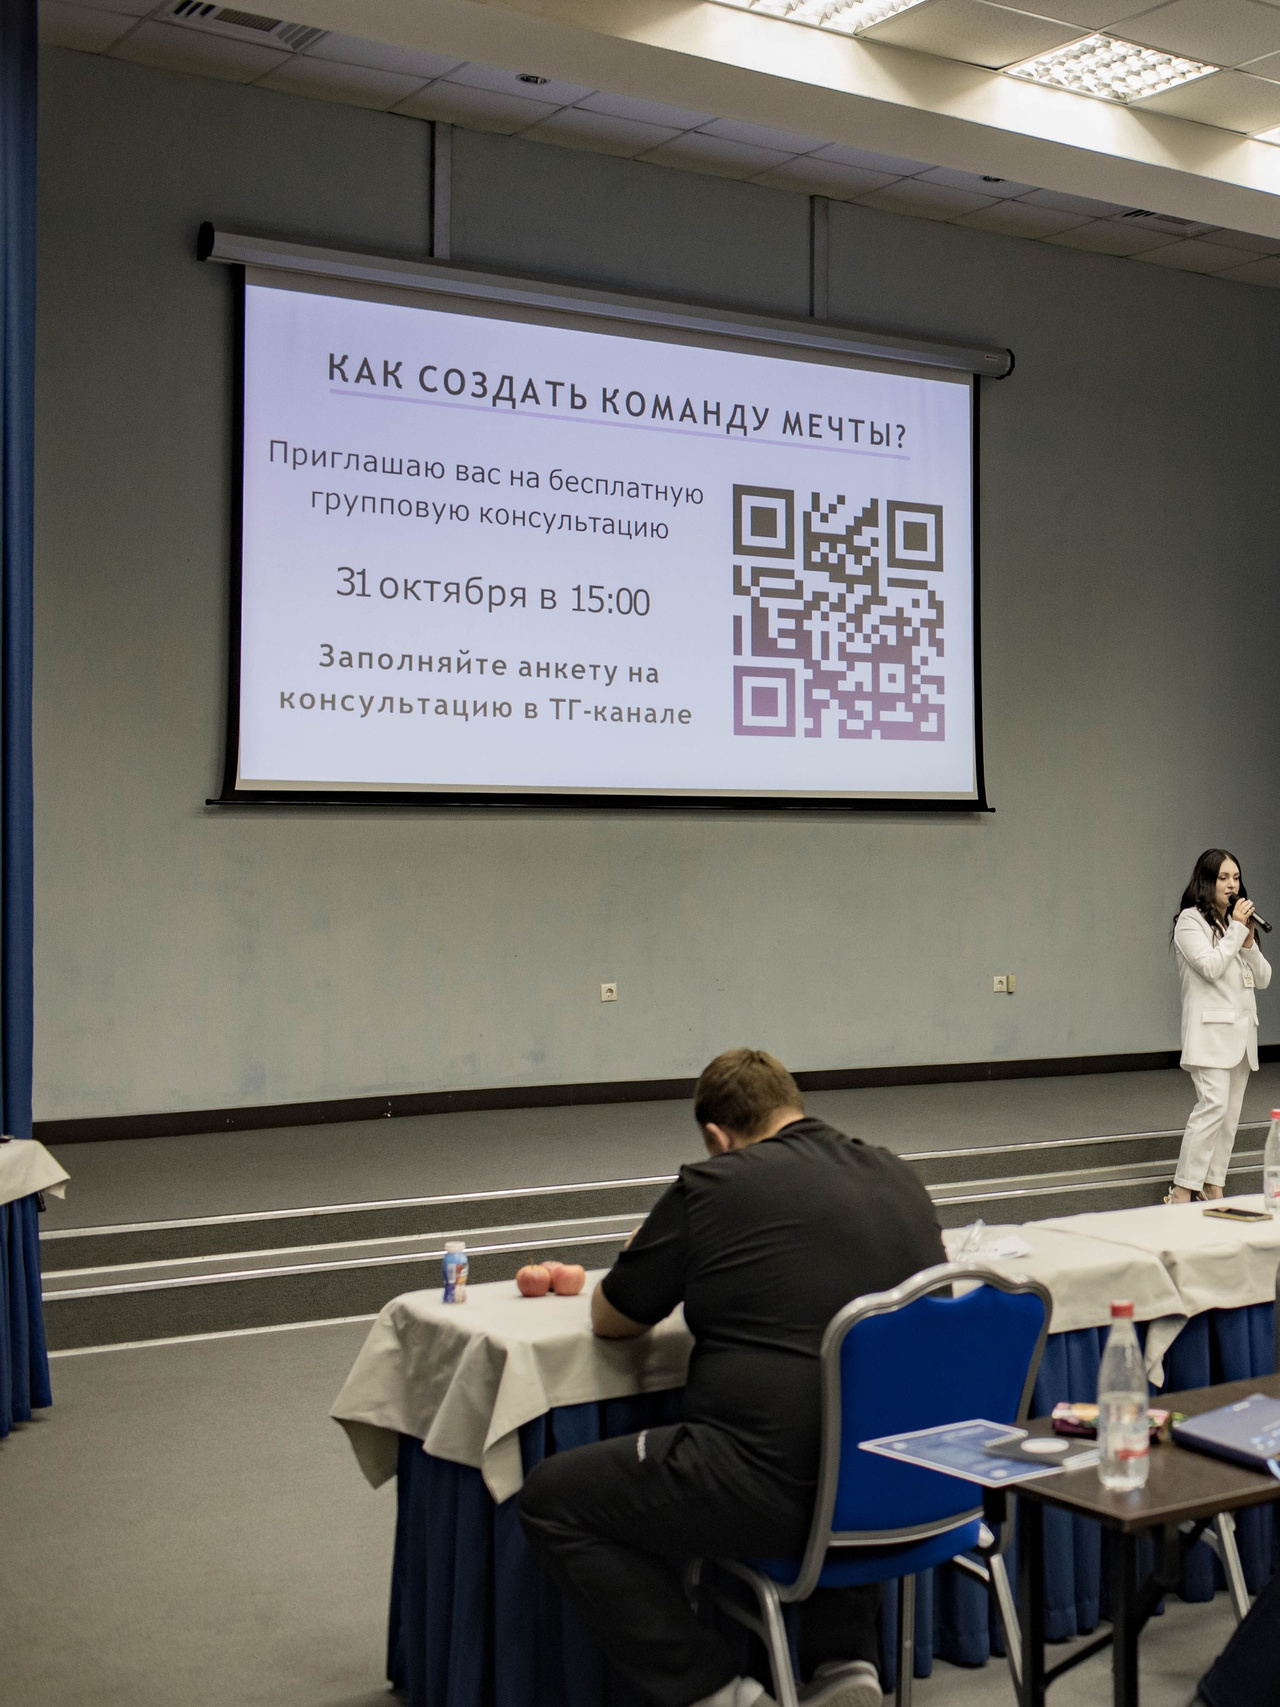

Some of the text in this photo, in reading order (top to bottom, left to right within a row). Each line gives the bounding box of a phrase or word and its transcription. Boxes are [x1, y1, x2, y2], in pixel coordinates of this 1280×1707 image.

[328, 352, 907, 449] КАК СОЗДАТЬ КОМАНДУ МЕЧТЫ?
[269, 439, 704, 508] Приглашаю вас на бесплатную
[311, 490, 669, 540] групповую консультацию
[336, 566, 651, 617] 31 октября в 15:00
[318, 643, 659, 687] Заполняйте анкету на
[280, 691, 692, 725] консультацию в ТГ-канале
